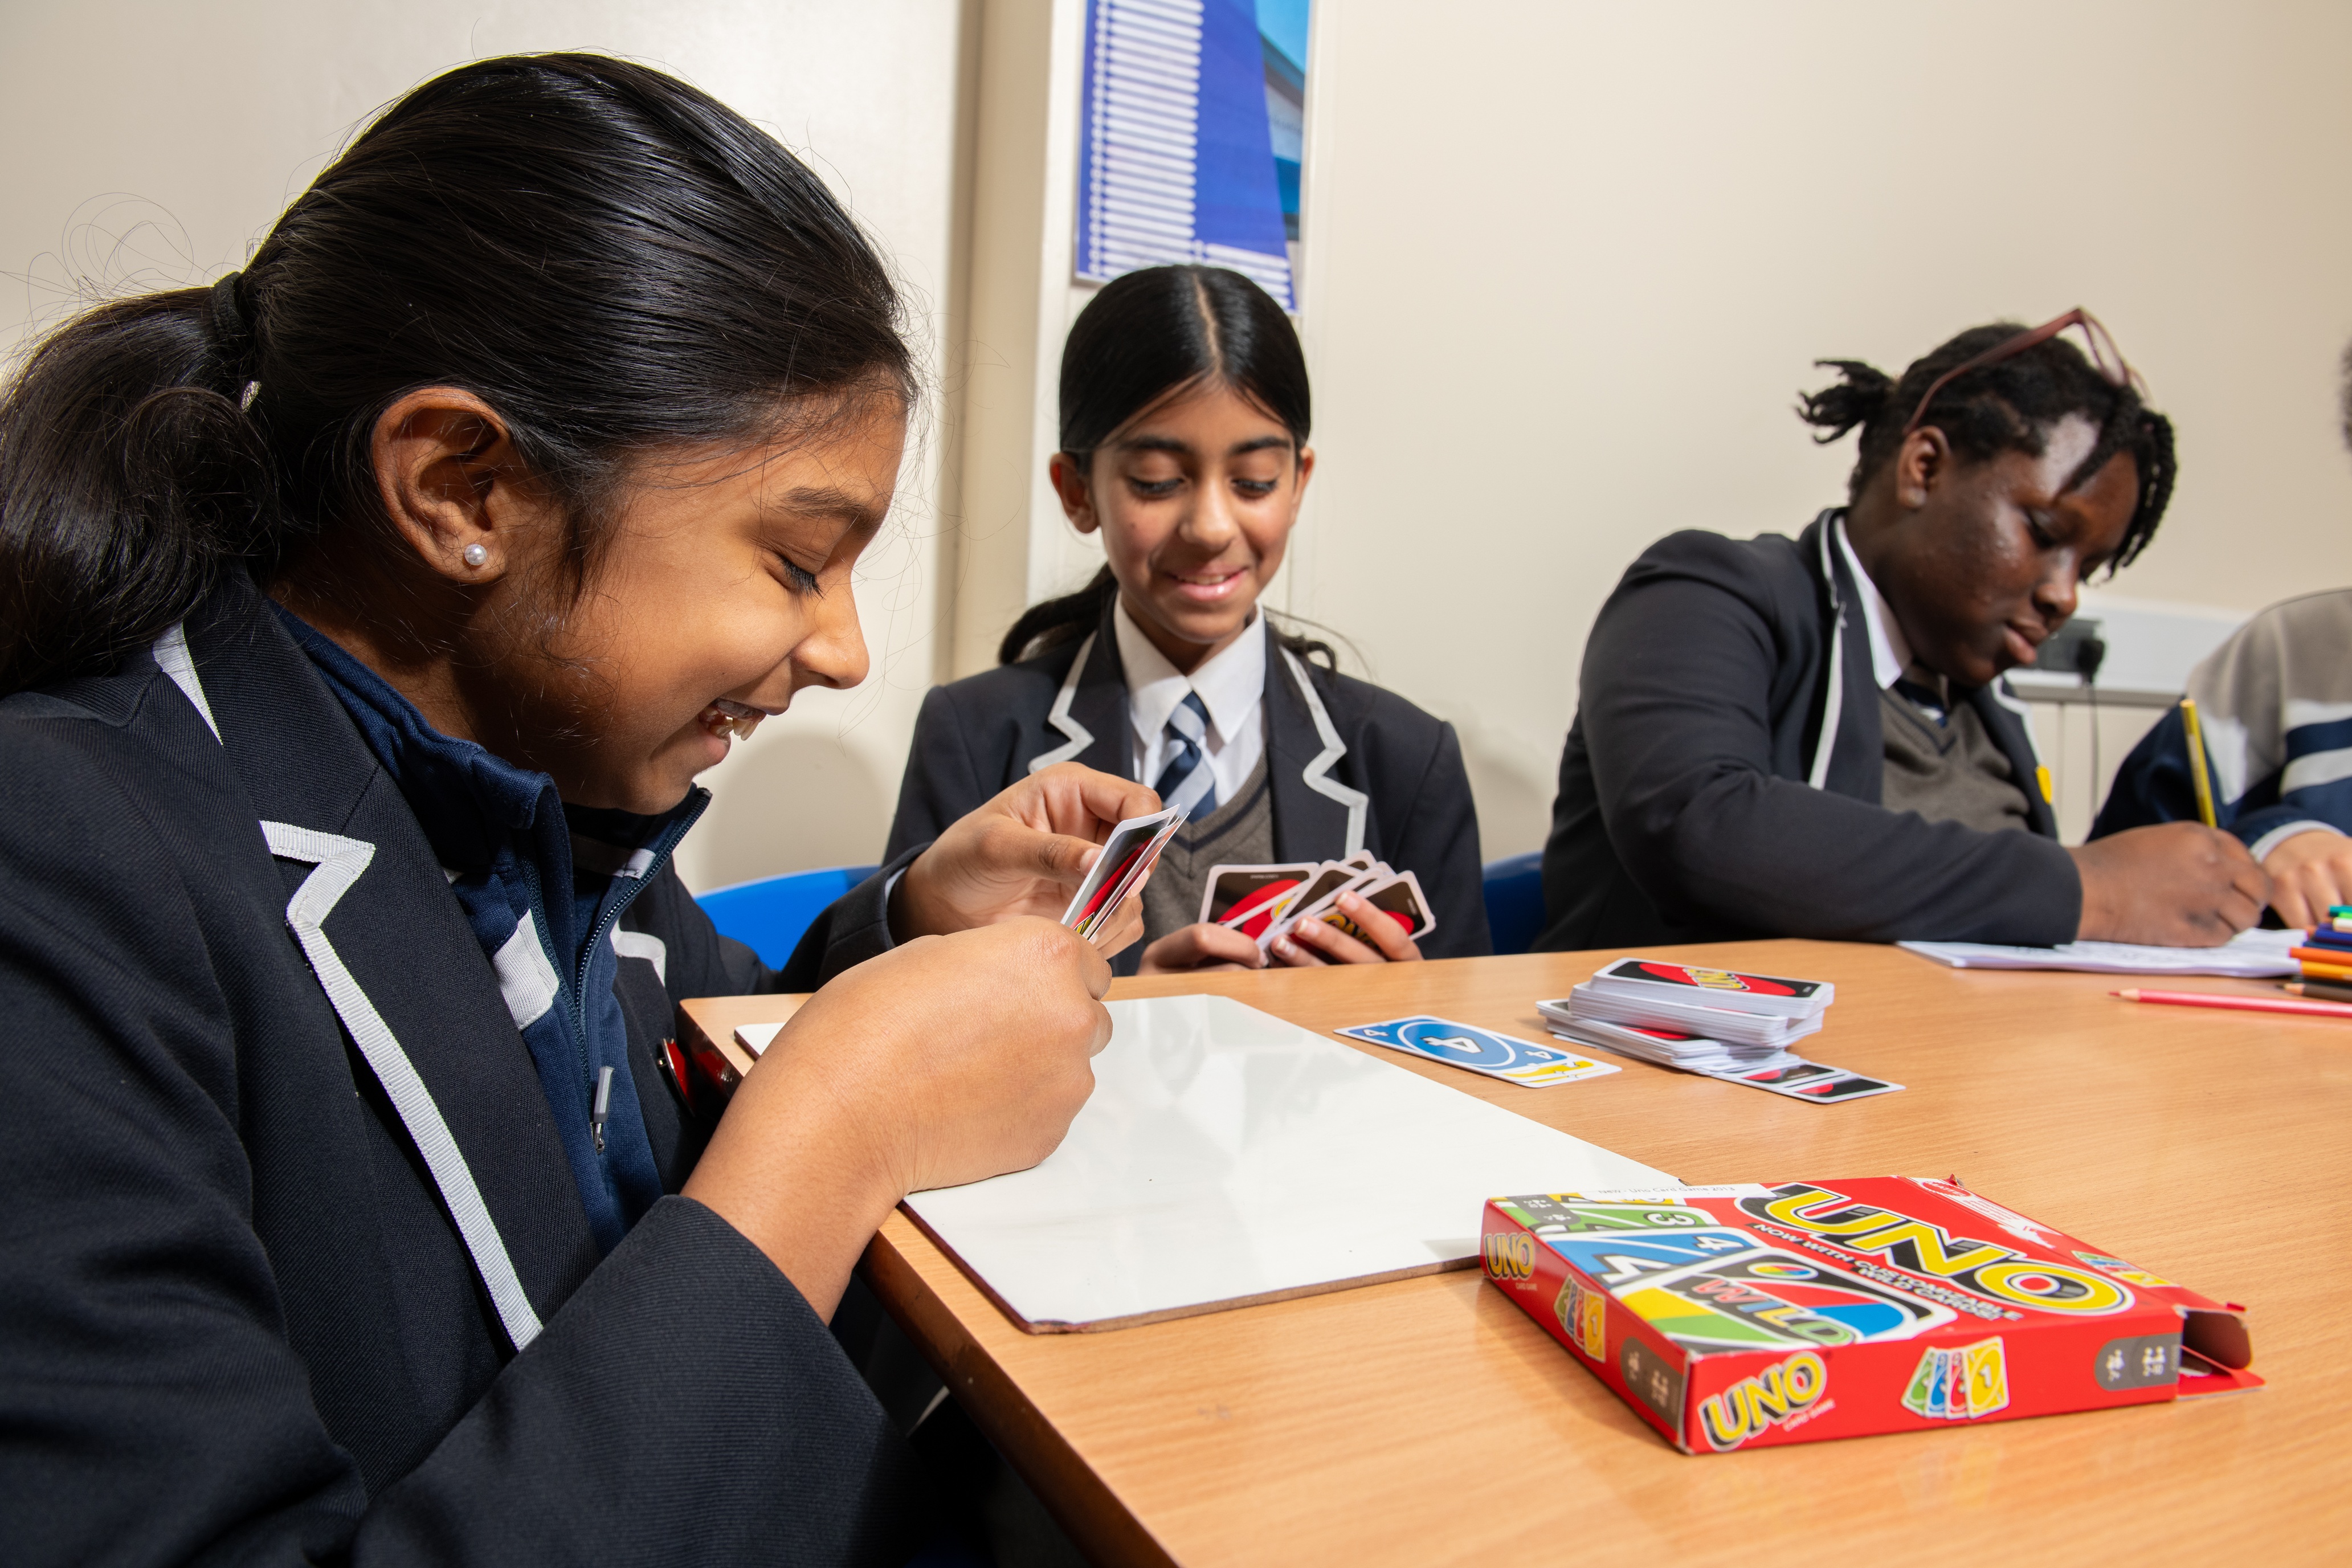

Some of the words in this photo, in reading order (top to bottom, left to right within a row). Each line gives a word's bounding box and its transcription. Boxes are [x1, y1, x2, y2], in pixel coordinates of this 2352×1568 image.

[1419, 1036, 1484, 1054] 4
[1644, 1212, 1696, 1226] 3
[1484, 1232, 1536, 1280] UNO
[1692, 1235, 1744, 1251] 4
[1742, 1184, 2133, 1314] UNO
[1753, 1223, 1803, 1243] NOW
[1802, 1241, 1855, 1263] WITH
[1854, 1260, 2024, 1321] CUSTOMIZABLE
[1858, 1268, 1914, 1291] WILD
[1692, 1279, 1854, 1347] WILD
[1979, 1363, 1992, 1389] 1
[1698, 1351, 1827, 1451] UNO
